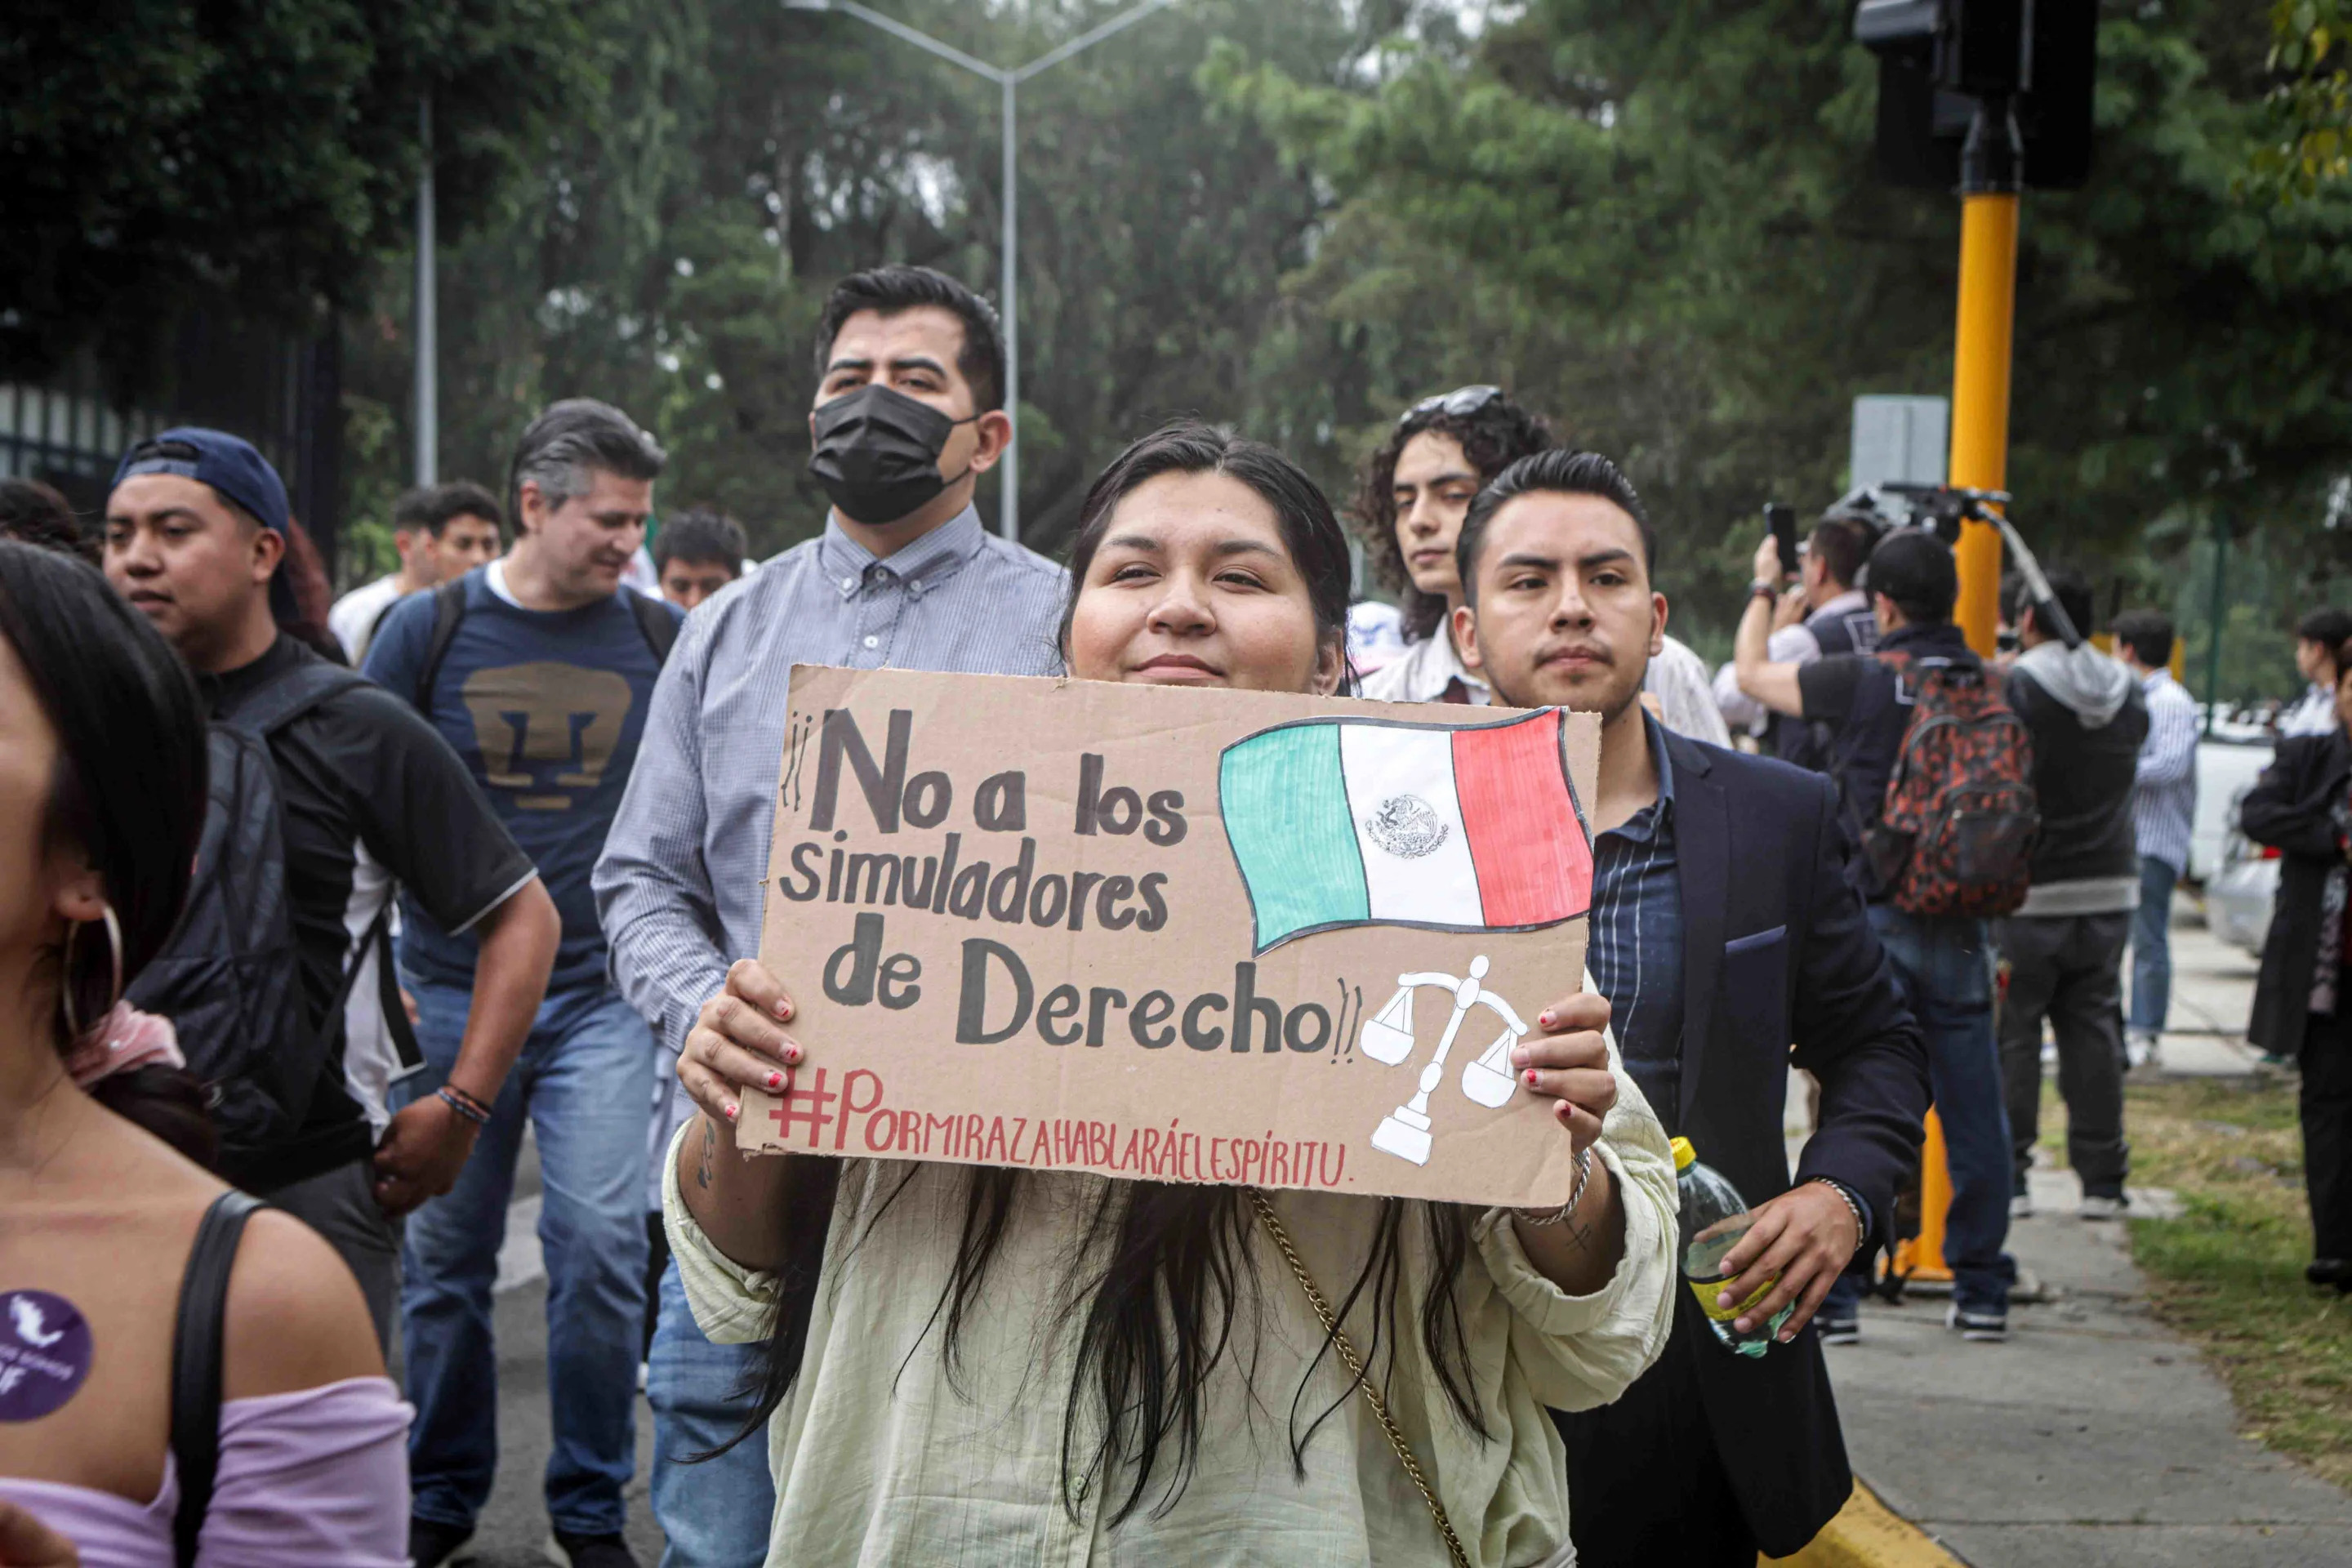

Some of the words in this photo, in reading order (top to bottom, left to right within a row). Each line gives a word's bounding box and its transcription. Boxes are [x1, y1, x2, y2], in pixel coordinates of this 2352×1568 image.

[973, 770, 1027, 832] a
[1074, 752, 1188, 847] los
[822, 912, 922, 1010] de
[956, 937, 1363, 1065] Derecho!!
